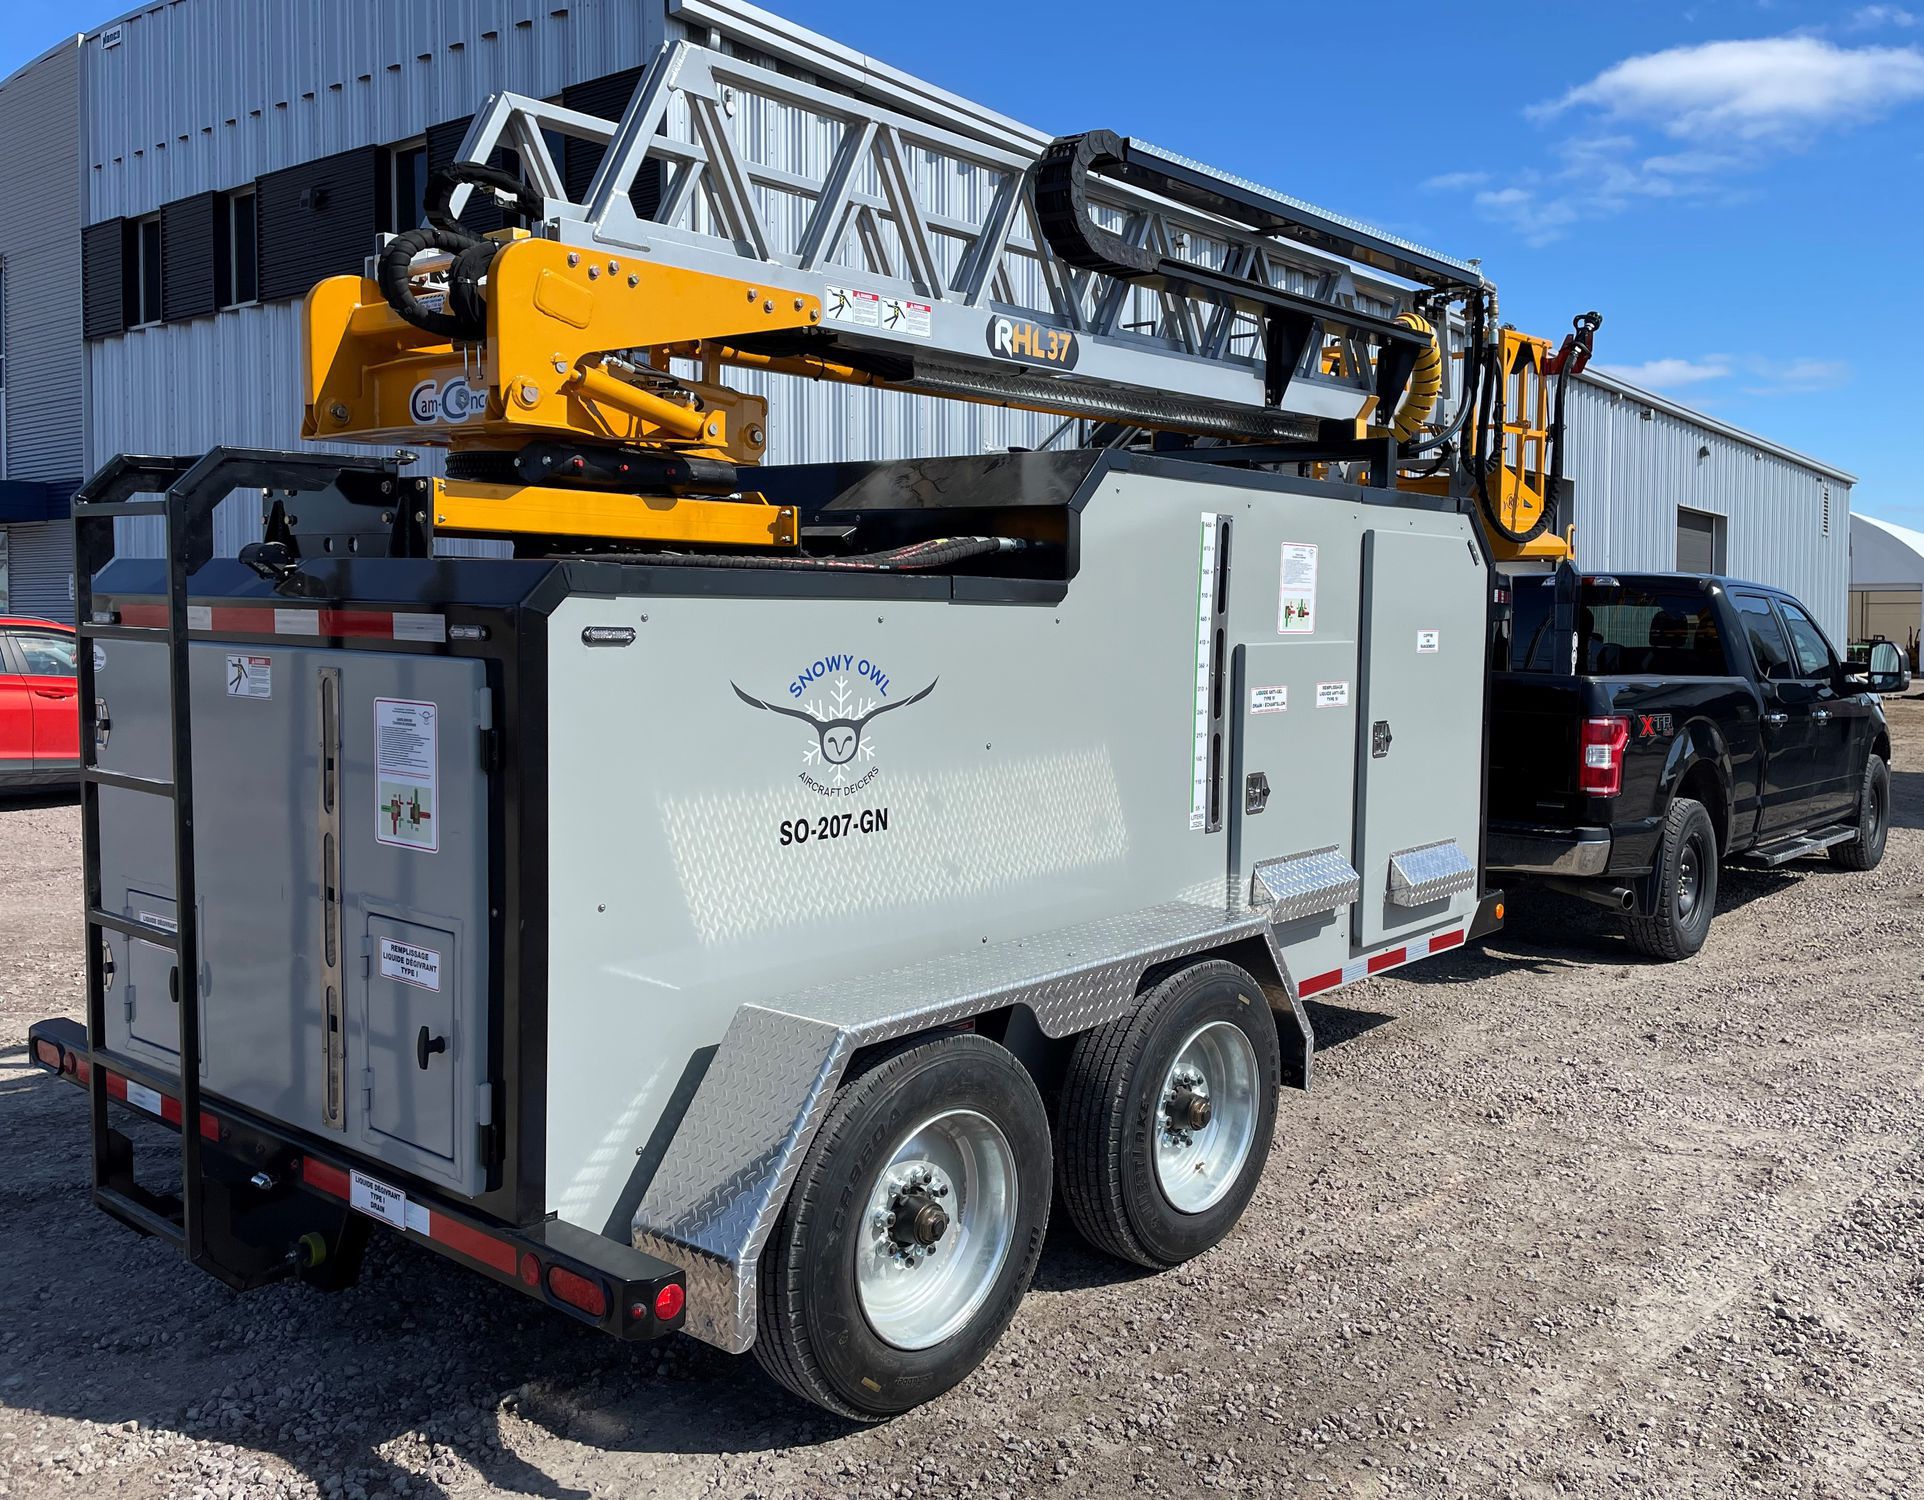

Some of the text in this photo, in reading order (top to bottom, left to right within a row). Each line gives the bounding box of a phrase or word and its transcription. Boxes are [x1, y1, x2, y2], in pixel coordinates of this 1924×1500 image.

[995, 318, 1072, 362] RHL 37
[789, 655, 890, 699] SNOWY OWL
[1638, 714, 1673, 736] XTR
[798, 765, 879, 798] AIRCRAFT DEICERS
[779, 807, 888, 846] SO-207-GN
[383, 952, 437, 973] LIQUIDE DÉGIVRANT
[391, 944, 429, 960] REMPLISSAGE
[401, 967, 415, 977] TYPE
[355, 1176, 373, 1190] LIQUIDE
[370, 1192, 382, 1203] TYPE
[370, 1201, 385, 1213] DRAIN
